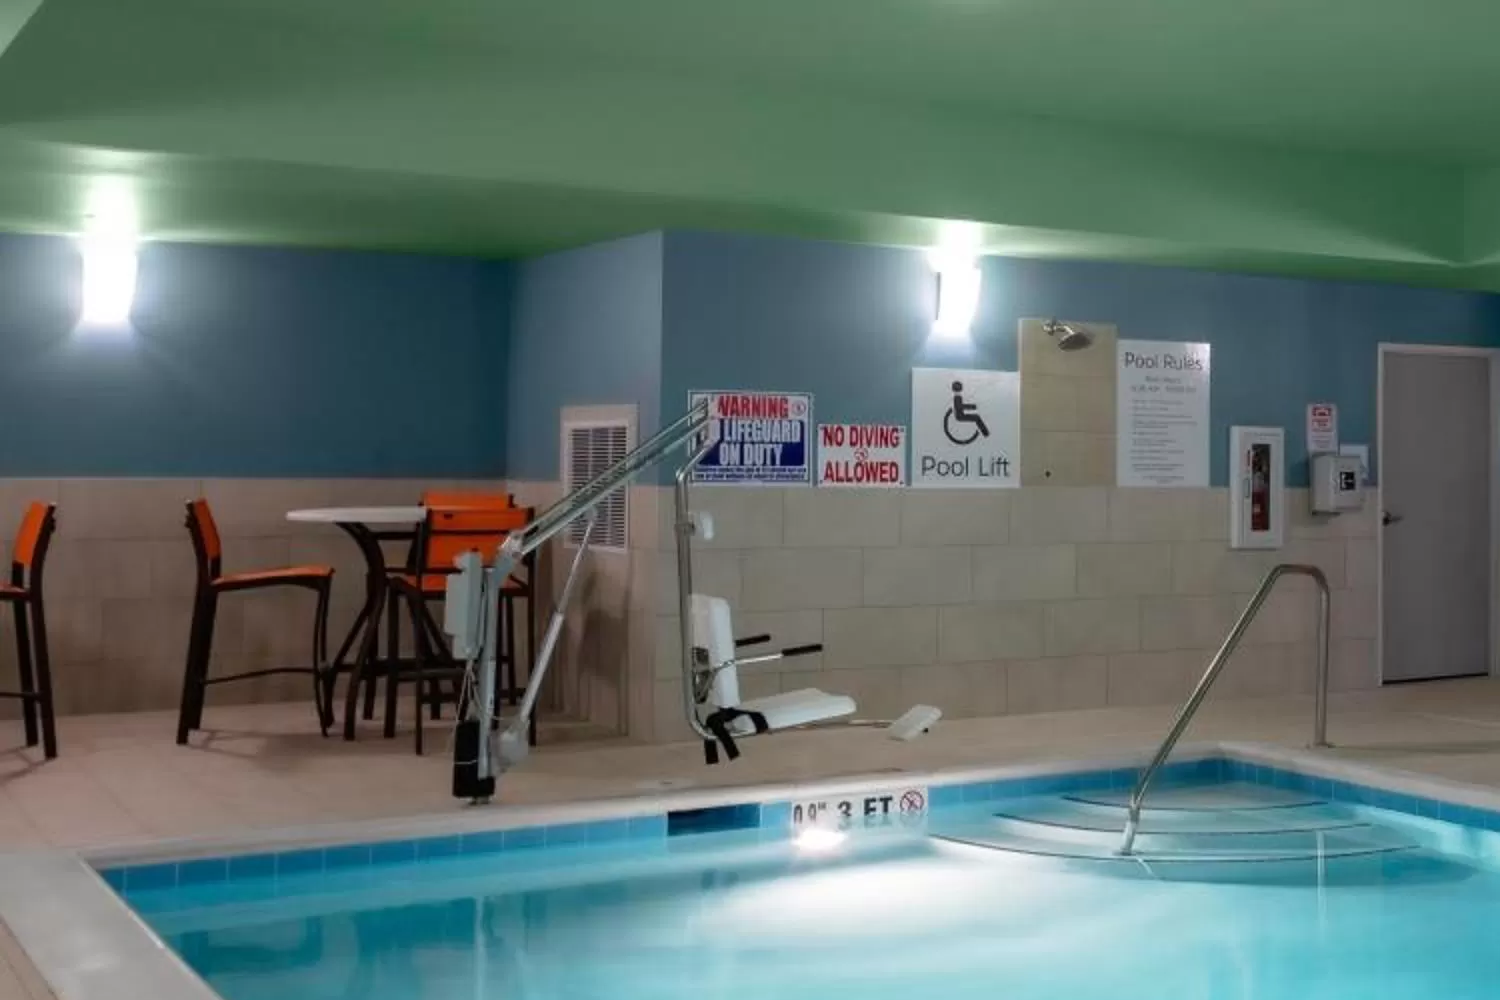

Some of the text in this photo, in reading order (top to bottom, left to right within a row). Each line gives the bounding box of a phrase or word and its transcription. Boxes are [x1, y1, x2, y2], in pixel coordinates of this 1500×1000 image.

[1124, 351, 1203, 371] Pool Rules
[723, 419, 801, 442] LIFEGUARD
[823, 425, 900, 449] NO DIVING
[719, 443, 783, 466] ON DUTY
[921, 455, 1010, 477] Pool Lift
[823, 460, 899, 483] ALLOWED
[863, 795, 894, 816] FT
